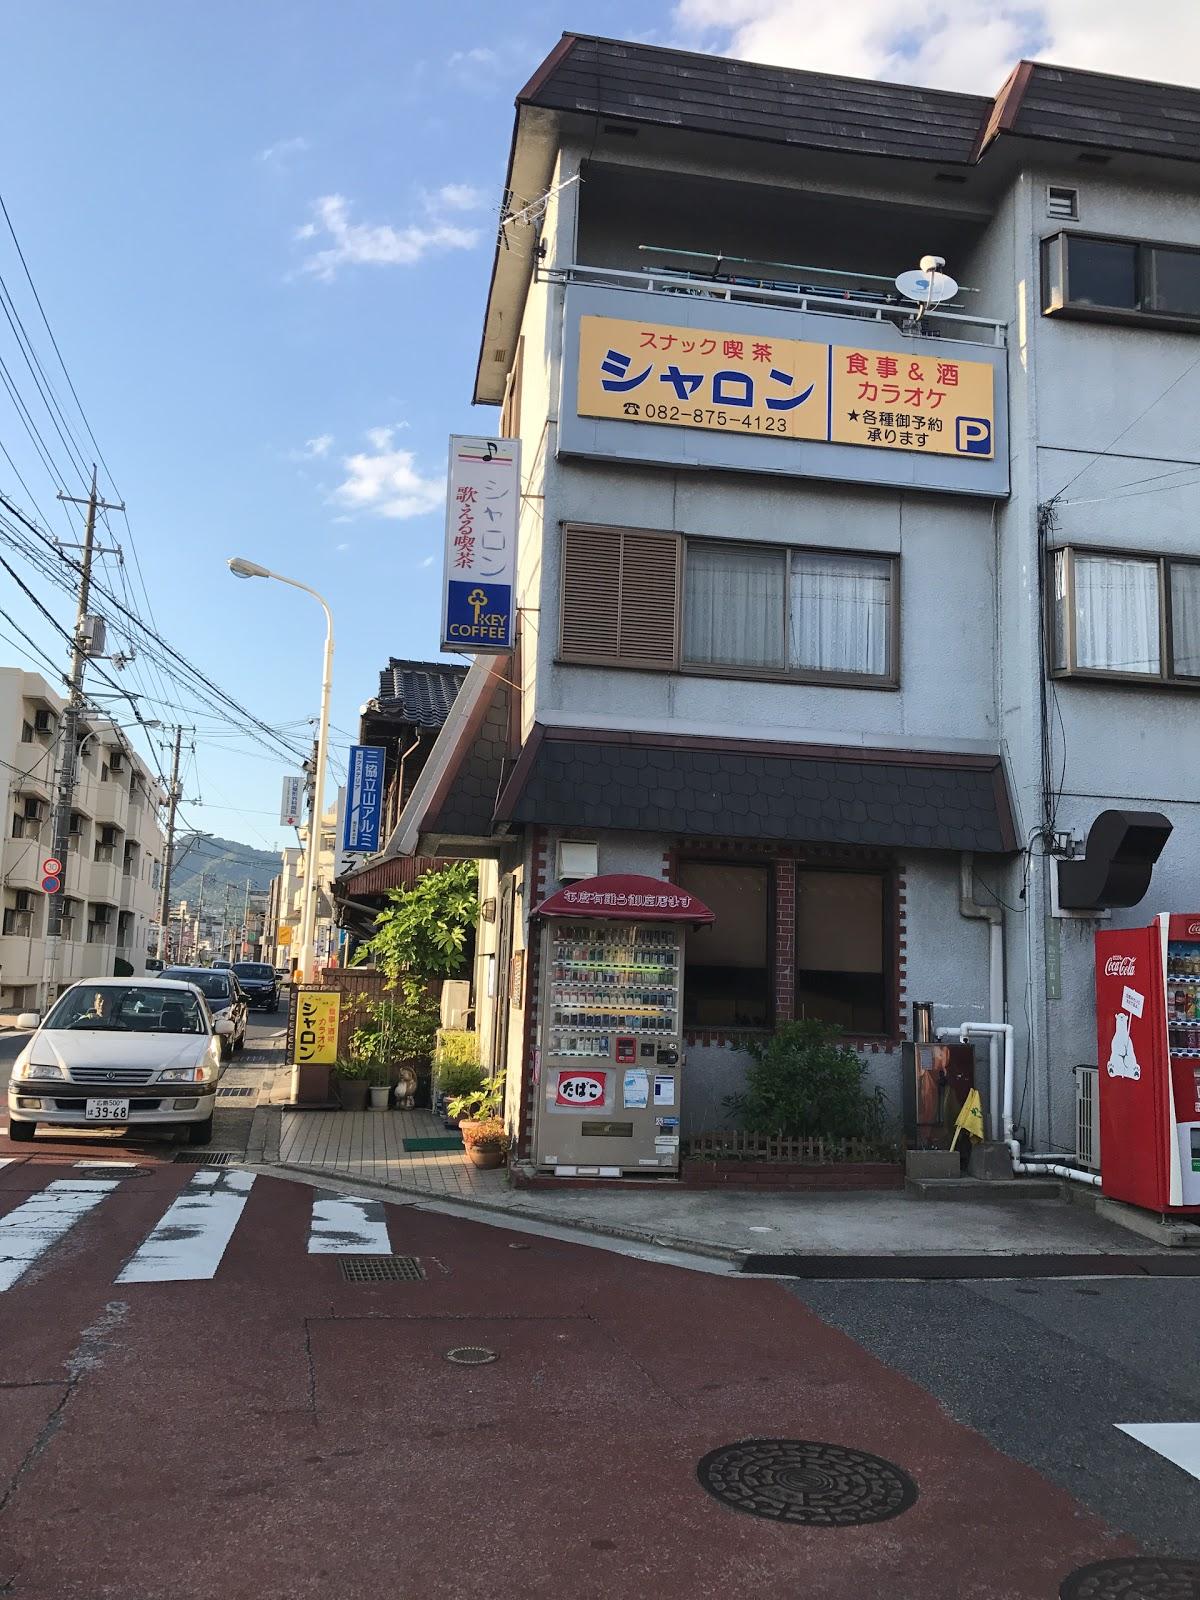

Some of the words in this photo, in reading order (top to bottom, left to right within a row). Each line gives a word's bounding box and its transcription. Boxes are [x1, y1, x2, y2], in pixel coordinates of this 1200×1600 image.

[639, 332, 772, 363] スナック喫茶
[600, 349, 815, 411] シャロン
[857, 381, 947, 409] カラオケ
[645, 403, 787, 433] 082-875-4123
[867, 427, 929, 447] 承ります
[959, 419, 989, 451] P
[454, 486, 479, 569] 歌える喫茶
[480, 480, 509, 576] シャロン
[449, 623, 506, 639] COFFEE
[480, 614, 508, 627] KEY
[47, 863, 57, 871] 30
[299, 1002, 318, 1060] シャロン
[563, 1081, 598, 1098] たばこ
[95, 1107, 126, 1118] 39-68
